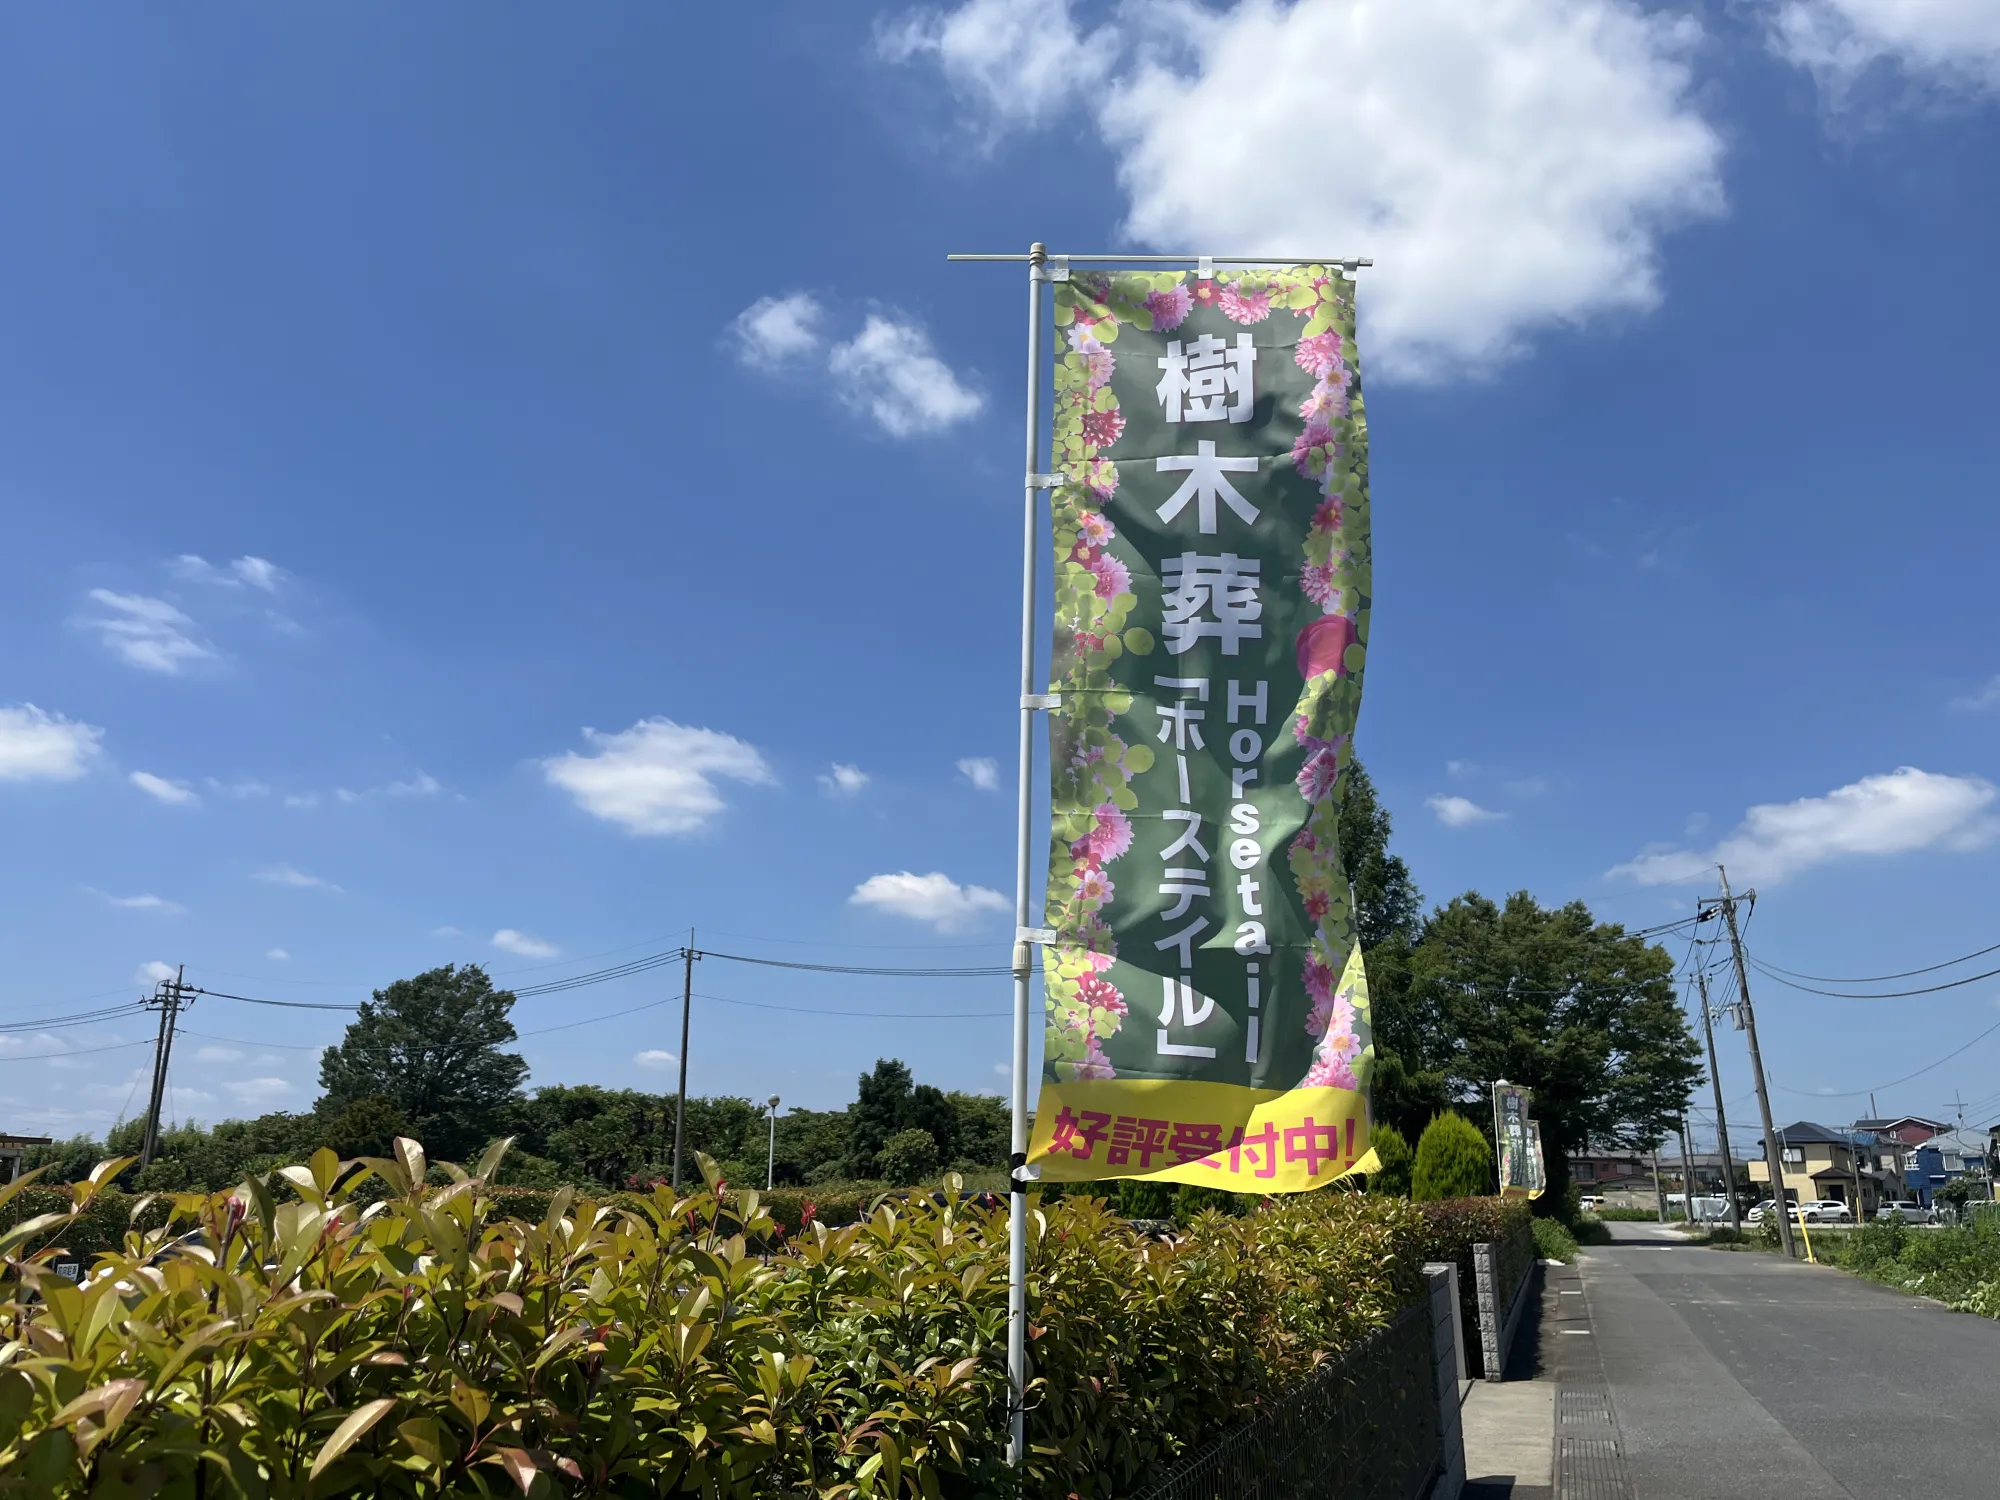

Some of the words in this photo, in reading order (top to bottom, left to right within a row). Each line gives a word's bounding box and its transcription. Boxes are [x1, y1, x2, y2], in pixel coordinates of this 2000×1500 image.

[1155, 333, 1262, 655] 樹木葬
[1153, 675, 1216, 1059] 「ホーステイル」
[1227, 679, 1271, 1063] Horsetail
[1047, 1106, 1356, 1179] 好評受付中!
